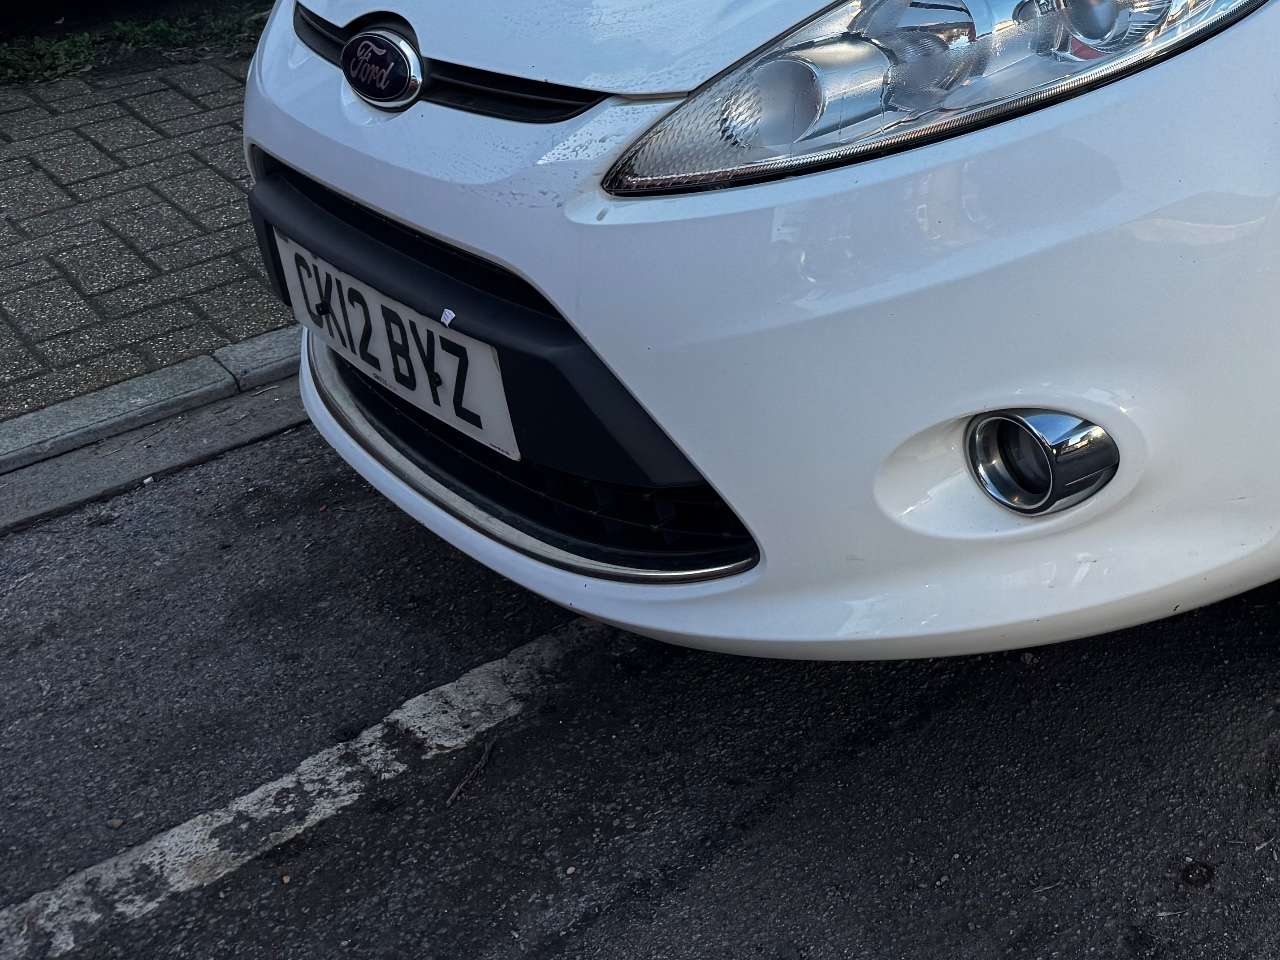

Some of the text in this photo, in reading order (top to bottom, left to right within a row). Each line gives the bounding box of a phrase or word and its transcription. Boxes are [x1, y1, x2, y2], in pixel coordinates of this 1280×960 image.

[350, 40, 395, 90] Ford
[294, 252, 483, 430] CK12 BYZ
